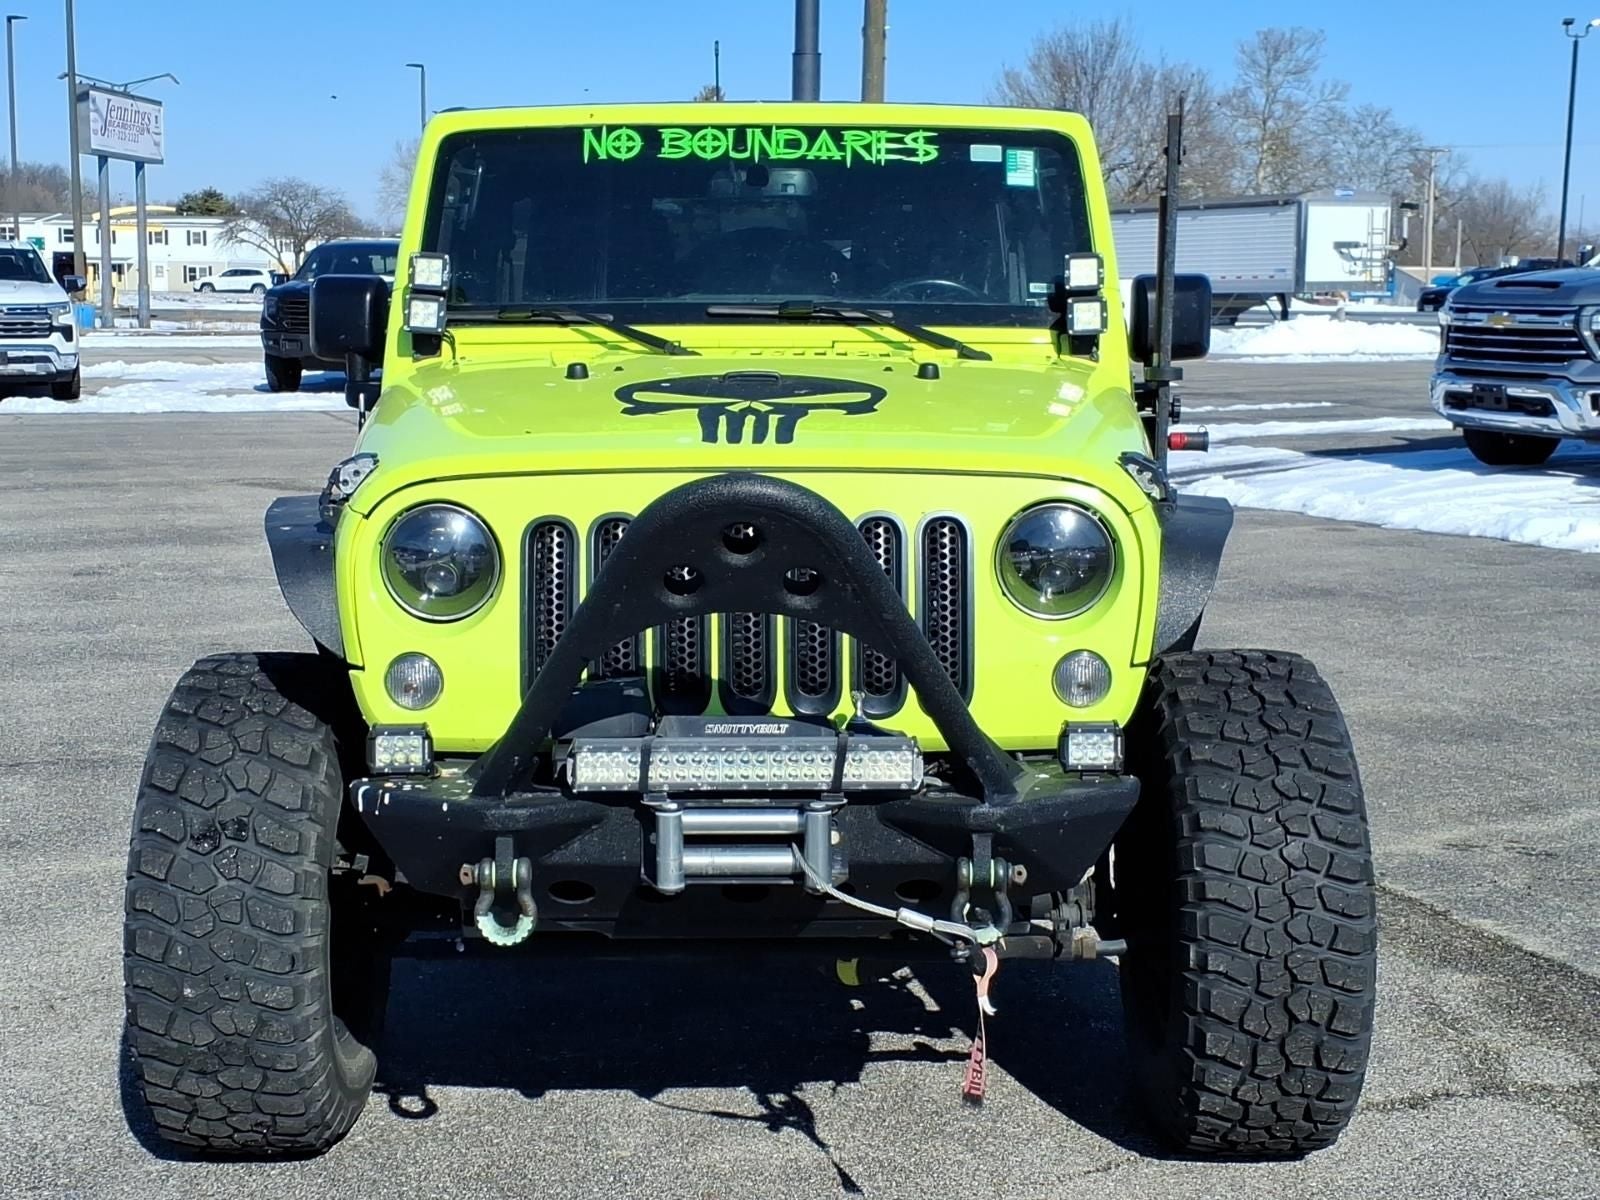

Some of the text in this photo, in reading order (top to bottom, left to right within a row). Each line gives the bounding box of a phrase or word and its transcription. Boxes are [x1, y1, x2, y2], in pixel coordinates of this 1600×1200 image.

[100, 98, 152, 136] Jennings
[107, 119, 151, 135] BEARDSTOWN
[583, 124, 939, 168] NO BOUNDARIES
[704, 723, 789, 734] SMITTYBILT
